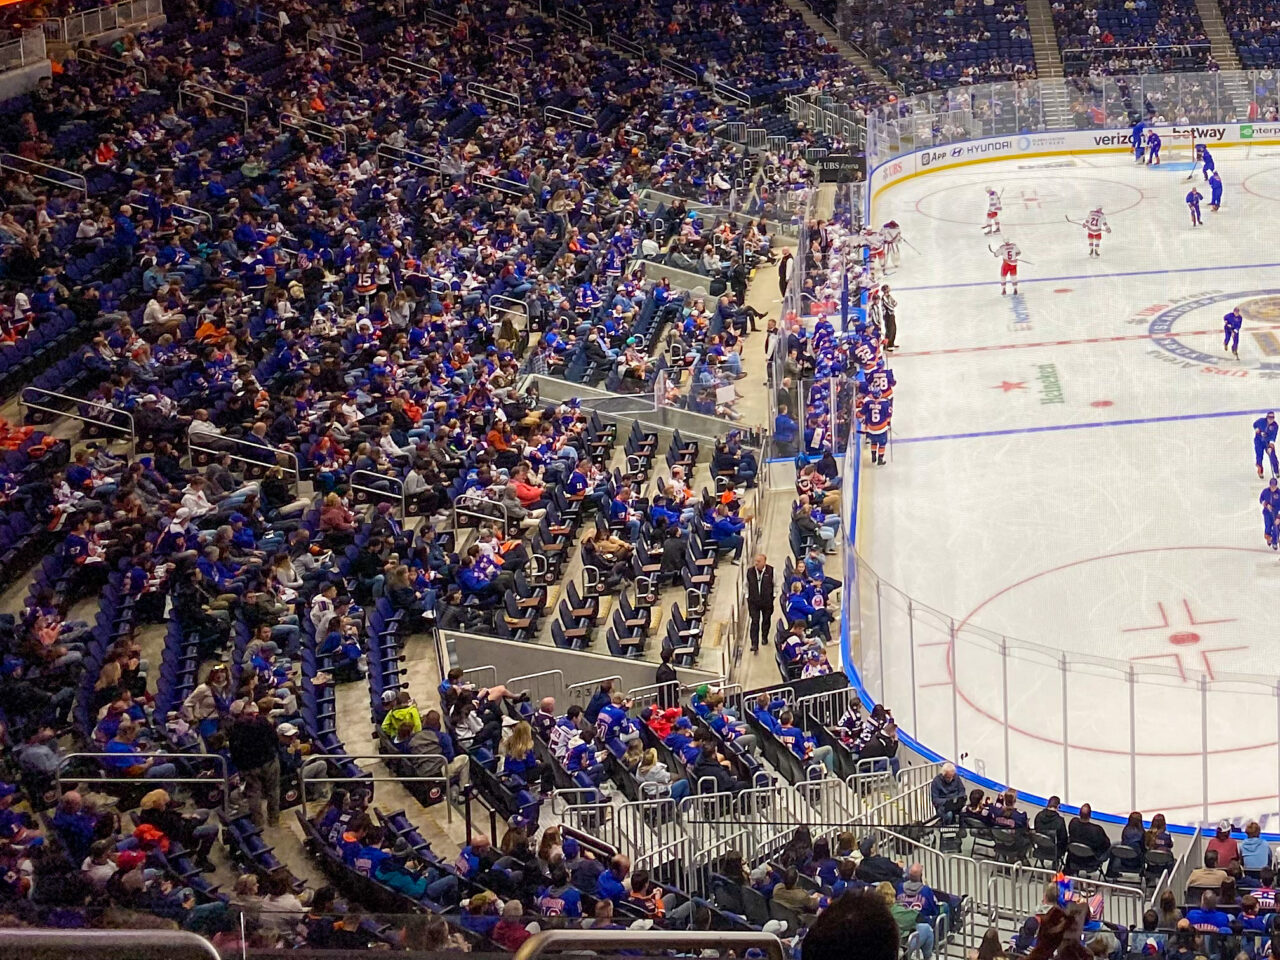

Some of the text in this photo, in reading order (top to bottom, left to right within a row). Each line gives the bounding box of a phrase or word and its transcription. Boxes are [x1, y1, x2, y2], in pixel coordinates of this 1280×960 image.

[966, 141, 1012, 156] HYUNDAI
[823, 161, 839, 170] UBS
[888, 162, 902, 177] UBS
[1090, 217, 1099, 227] 21
[358, 273, 371, 286] 15
[857, 348, 873, 363] 32
[871, 410, 880, 423] 6
